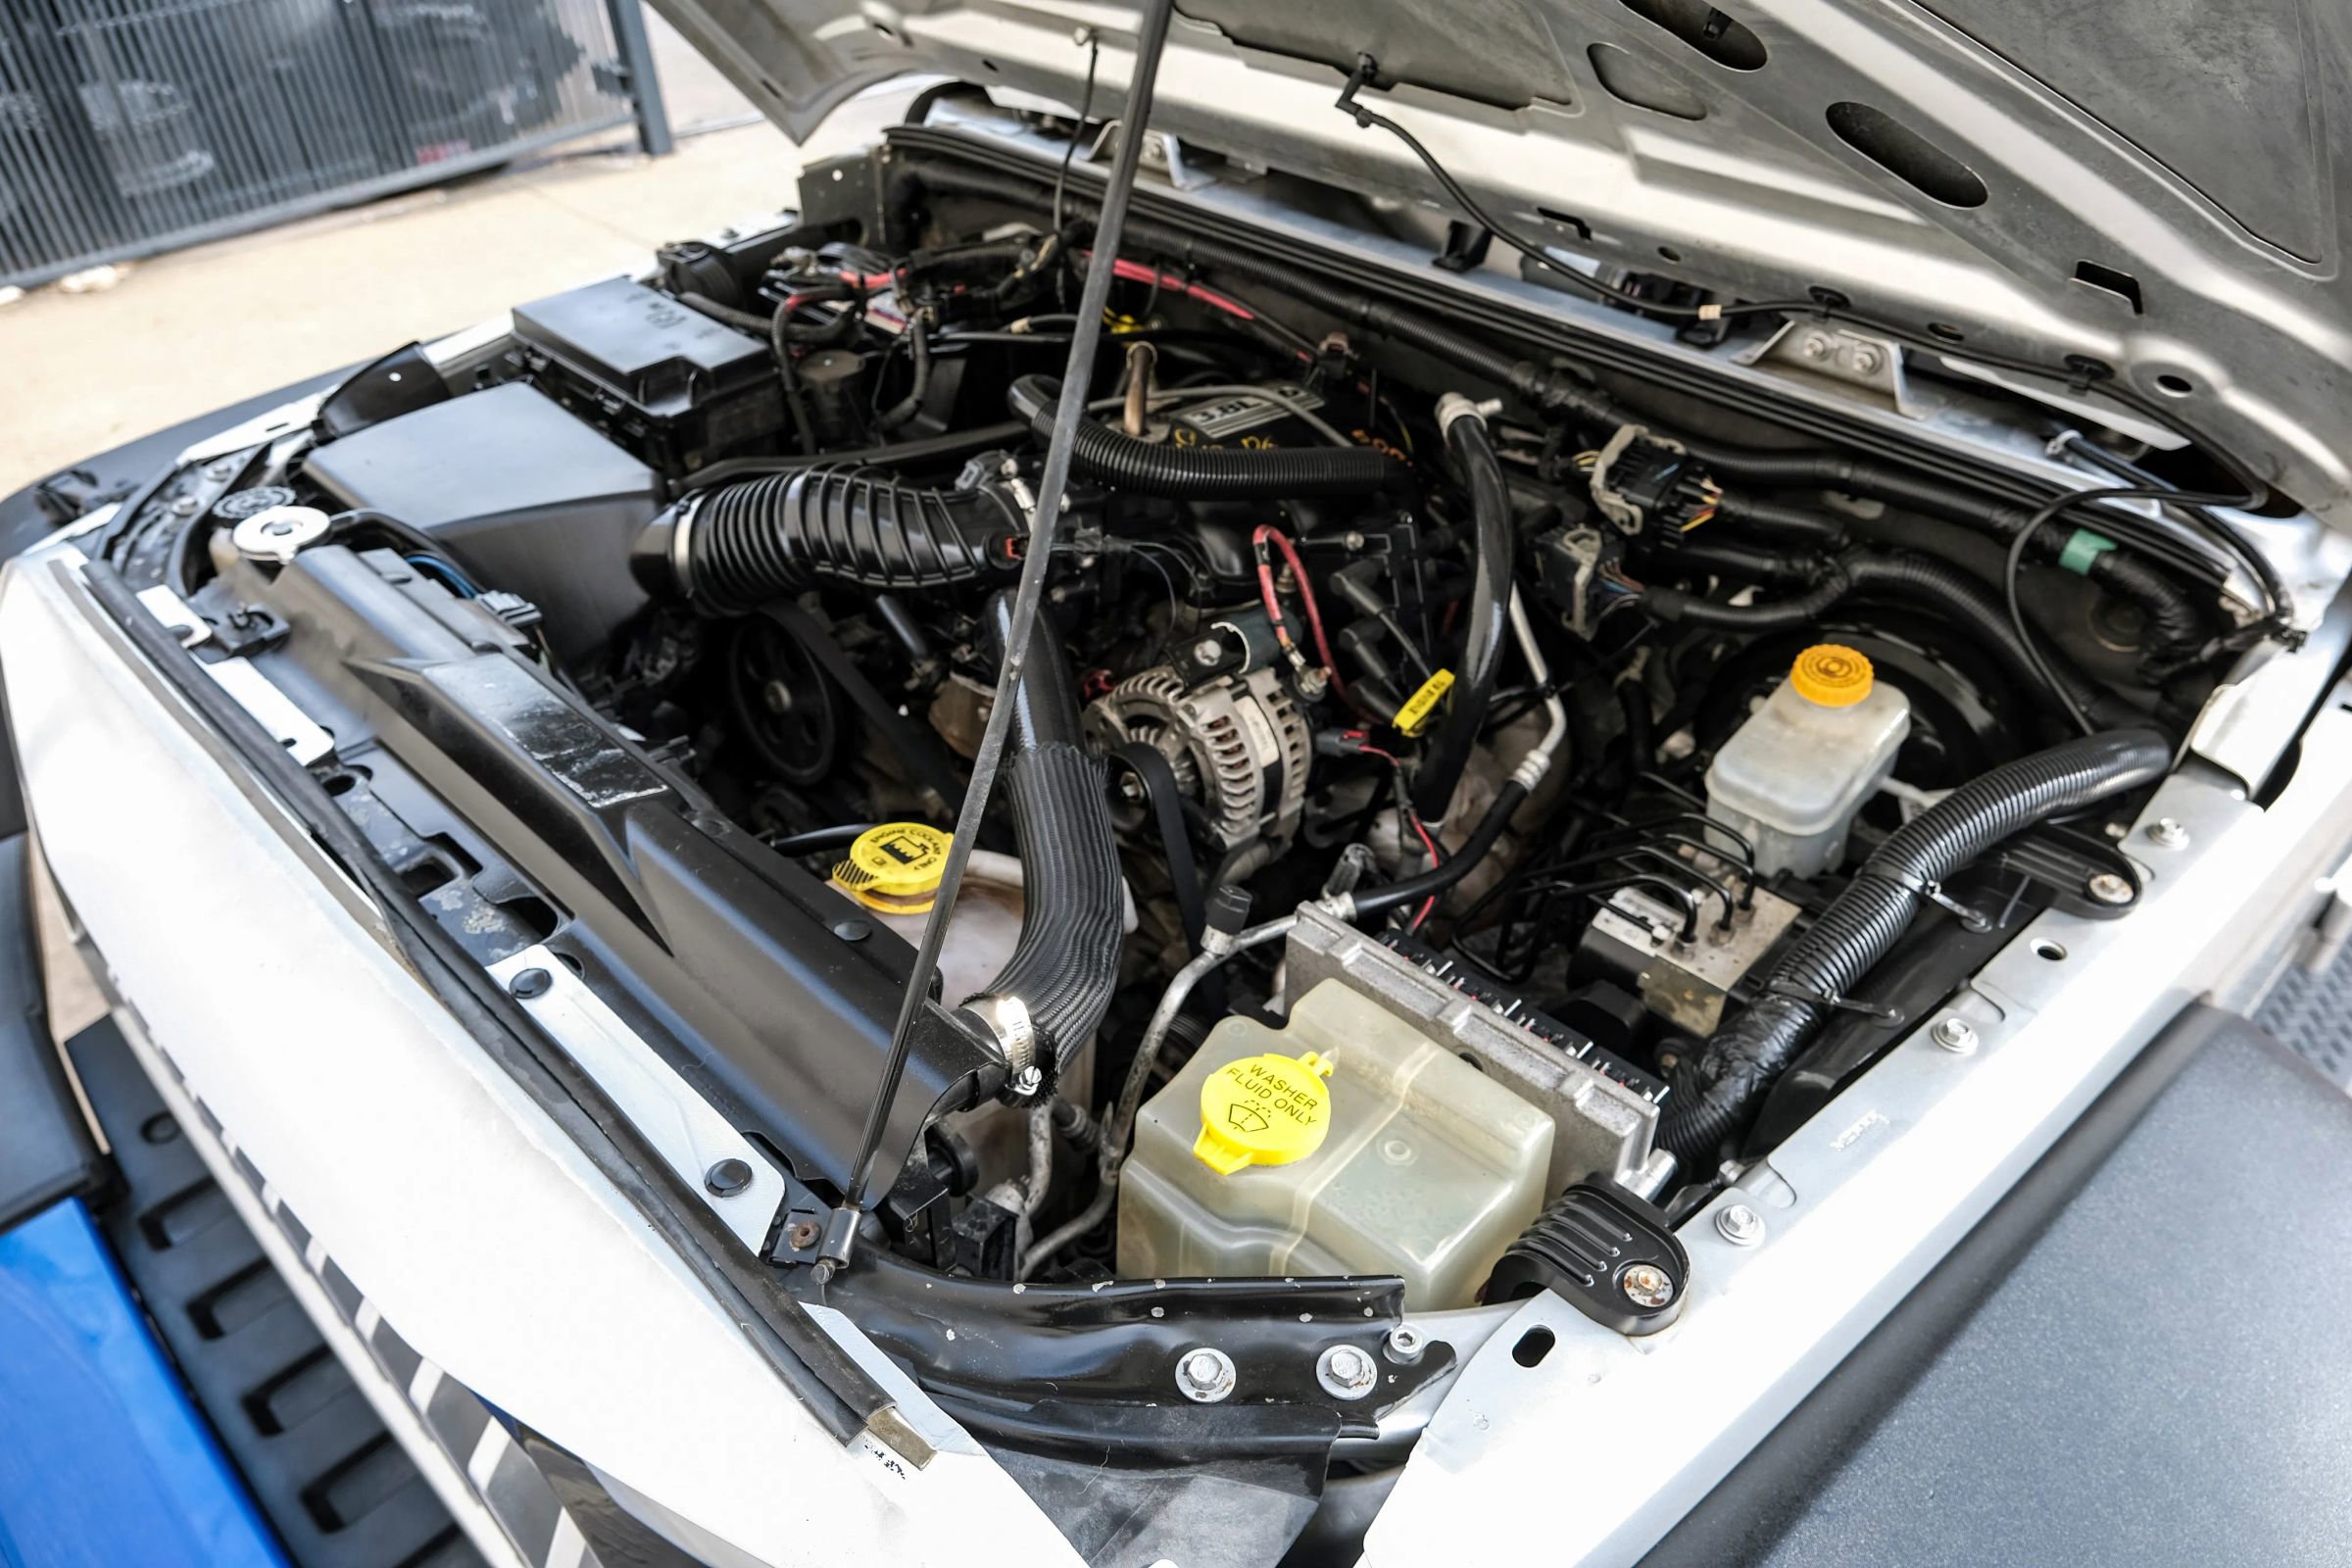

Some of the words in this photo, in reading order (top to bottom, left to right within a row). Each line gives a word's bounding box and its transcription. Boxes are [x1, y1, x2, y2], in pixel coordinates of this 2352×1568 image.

[870, 828, 906, 843] ENGINE
[909, 829, 942, 855] COOLANT
[1226, 1067, 1272, 1100] FLUID
[1274, 1098, 1317, 1126] ONLY
[1250, 1063, 1318, 1110] WASHER
